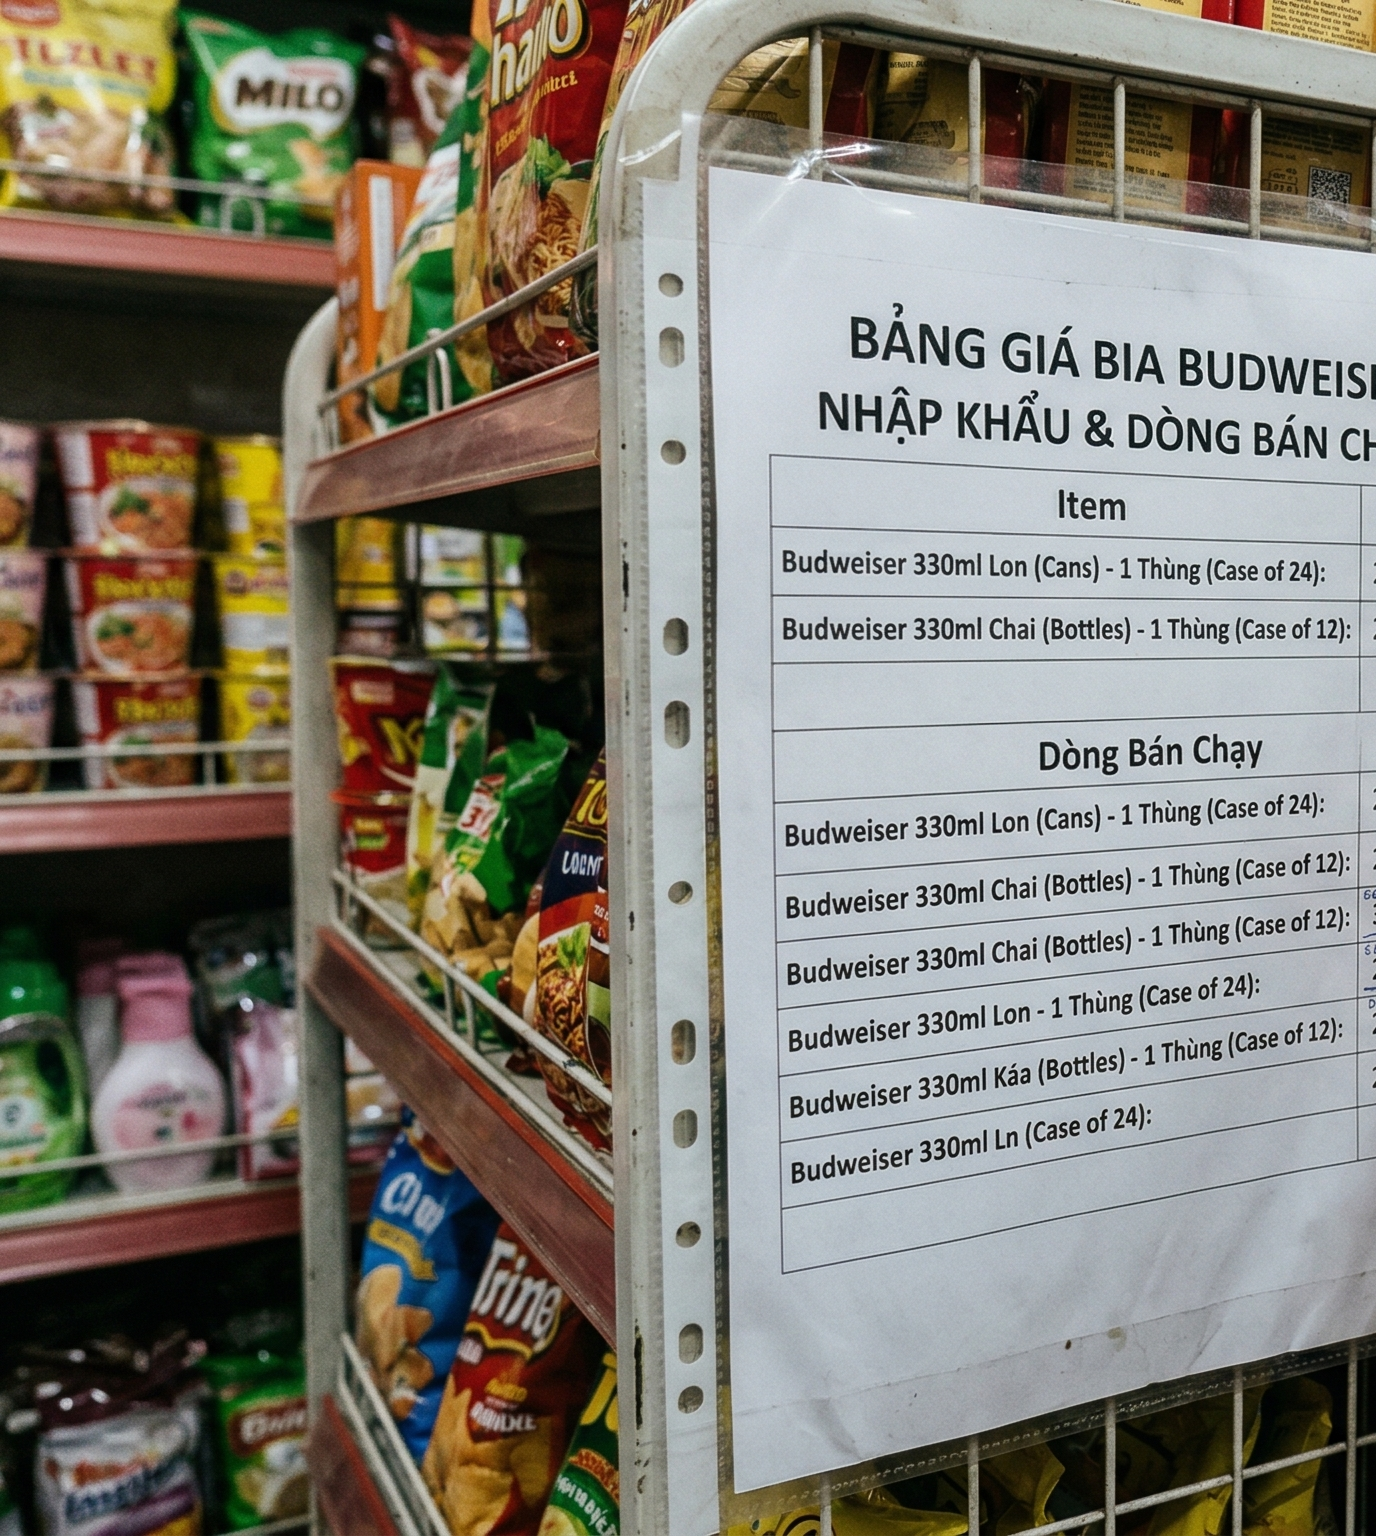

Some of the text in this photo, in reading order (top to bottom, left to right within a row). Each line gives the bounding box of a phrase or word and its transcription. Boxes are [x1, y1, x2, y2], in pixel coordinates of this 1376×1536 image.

[236, 75, 349, 115] MILO
[850, 302, 986, 370] BẢNG
[1001, 325, 1081, 378] GIÁ
[1094, 339, 1166, 385] BIA
[818, 385, 943, 445] NHẬP
[957, 389, 1070, 445] KHẨU
[1084, 409, 1115, 449] &
[1127, 405, 1240, 455] DÒNG
[1253, 413, 1328, 460] BÁN
[1058, 488, 1126, 521] Item
[782, 548, 908, 576] Budweiser
[913, 552, 982, 577] 330ml
[989, 554, 1028, 578] Lon
[1034, 553, 1100, 584] (Cans)
[1120, 557, 1132, 580] 1
[1136, 556, 1202, 586] Thùng
[1206, 557, 1259, 586] (Case
[1263, 559, 1285, 582] of
[1288, 559, 1326, 588] 24):
[782, 615, 908, 641] Budweiser
[913, 616, 982, 641] 330ml
[988, 616, 1036, 641] Chai
[1042, 616, 1131, 646] (Bottles)
[1150, 618, 1163, 640] 1
[1166, 616, 1231, 645] Thùng
[1235, 616, 1287, 645] (Case
[1291, 617, 1313, 640] of
[1316, 617, 1351, 645] 12):
[1039, 733, 1264, 776] Dòng Bán Chạy
[785, 818, 909, 848] Budweiser
[915, 811, 984, 839] 330ml
[991, 811, 1030, 834] Lon
[1036, 803, 1101, 837] (Cans)
[1121, 803, 1134, 826] 1
[1138, 799, 1202, 827] Thùng
[1207, 797, 1259, 825] (Case
[1264, 793, 1285, 817] of
[1288, 791, 1325, 819] 24):
[785, 888, 910, 920] Budweiser
[915, 878, 985, 908] 330ml
[991, 875, 1037, 902] Chai
[1044, 866, 1132, 903] (Bottles)
[1151, 866, 1163, 888] 1
[1168, 861, 1230, 888] Thùng
[1235, 857, 1286, 886] (Case
[1291, 852, 1312, 876] of
[1315, 850, 1351, 878] 12):
[786, 953, 910, 986] Budweiser
[916, 941, 985, 973] 330ml
[991, 936, 1038, 964] Chai
[1044, 926, 1132, 964] (Bottles)
[1151, 925, 1164, 947] 1
[1167, 919, 1230, 946] Thùng
[1235, 915, 1286, 943] (Case
[1290, 908, 1312, 933] of
[1315, 905, 1350, 933] 12):
[788, 1018, 911, 1053] Budweiser
[917, 1004, 986, 1037] 330ml
[993, 1004, 1031, 1027] Lon
[1051, 996, 1064, 1019] 1
[1068, 989, 1134, 1017] Thùng
[1139, 984, 1193, 1013] (Case
[1197, 976, 1219, 1001] of
[1222, 971, 1260, 1000] 24):
[789, 1083, 912, 1119] Budweiser
[918, 1067, 987, 1100] 330ml
[994, 1062, 1032, 1089] Káa
[1037, 1046, 1125, 1087] (Bottles)
[1144, 1044, 1156, 1067] 1
[1160, 1037, 1223, 1064] Thùng
[1228, 1031, 1279, 1059] (Case
[1284, 1021, 1304, 1046] of
[1308, 1017, 1343, 1044] 12):
[791, 1102, 1152, 1185] Budweiser 330ml Ln (Case of 24):
